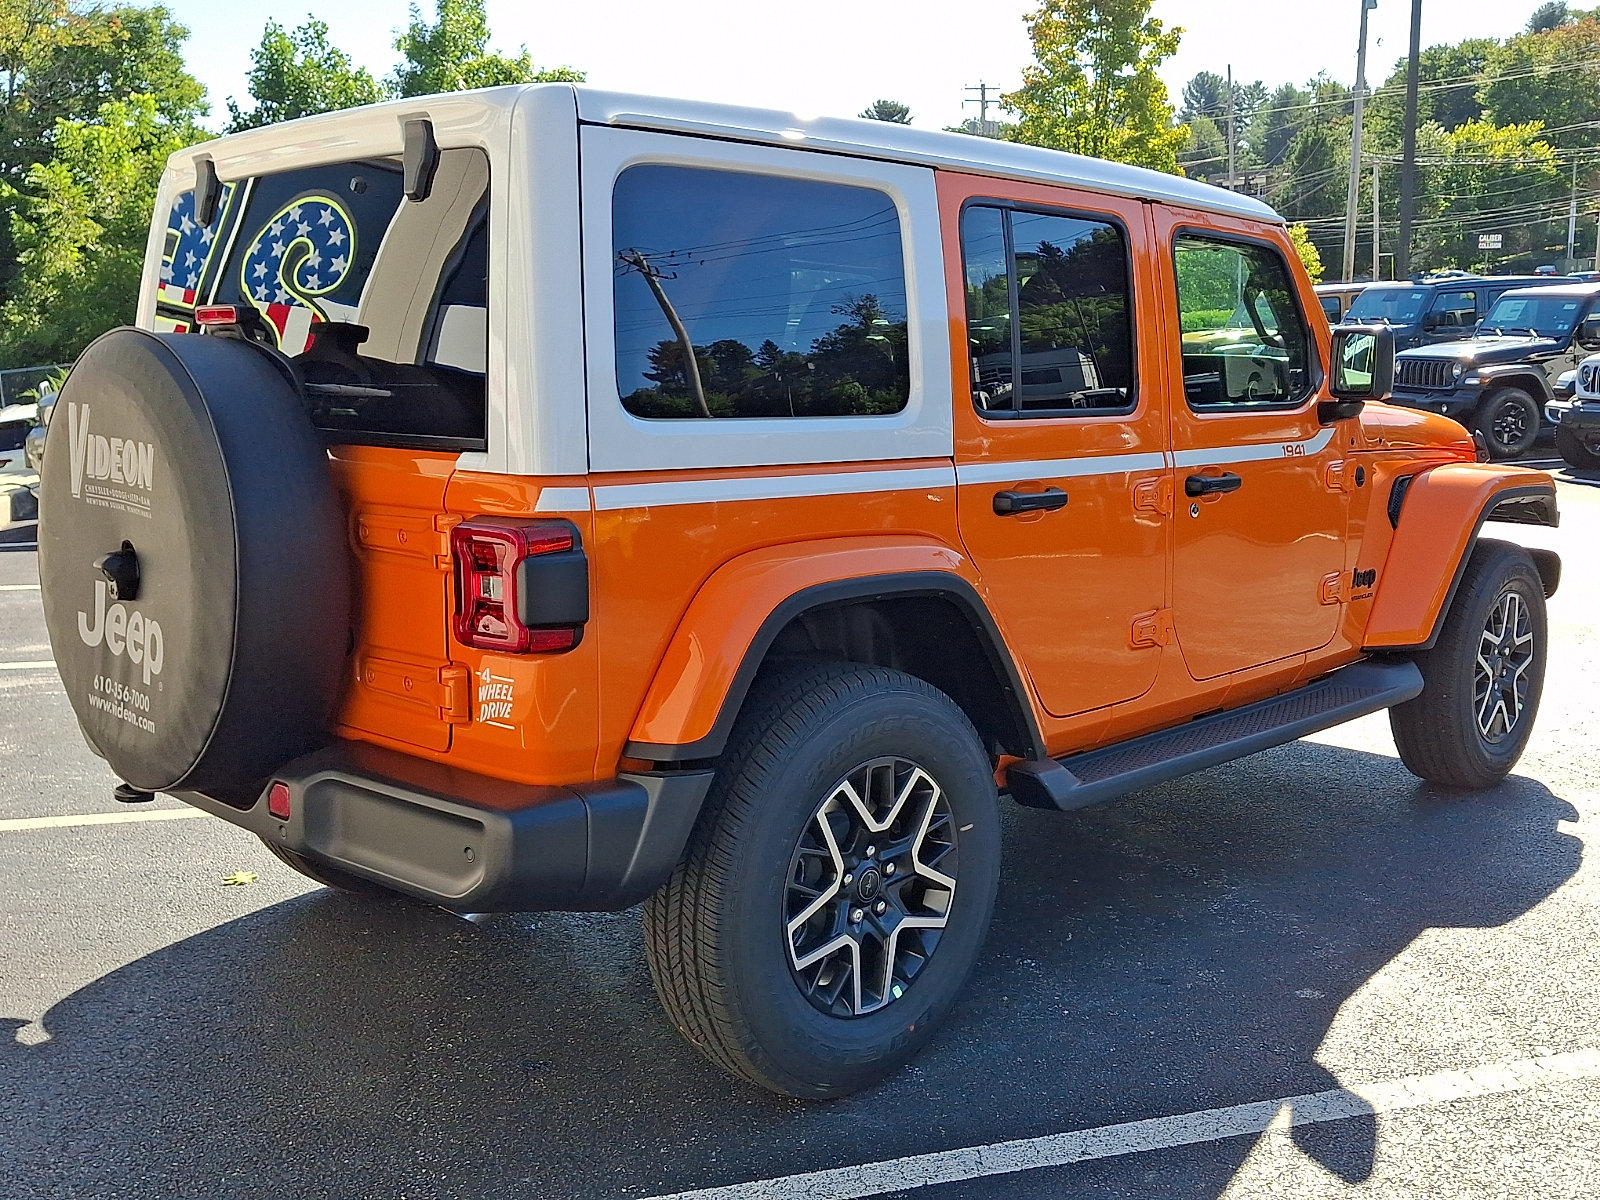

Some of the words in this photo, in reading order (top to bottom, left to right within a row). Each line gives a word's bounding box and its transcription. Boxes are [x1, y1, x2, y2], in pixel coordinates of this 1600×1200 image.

[68, 402, 154, 498] VIDEON
[1281, 444, 1306, 456] 1941
[77, 580, 164, 685] Jeep
[481, 667, 491, 683] 4
[93, 674, 150, 713] 610-356-7000
[478, 683, 513, 702] WHEEL
[88, 693, 156, 734] www.videon.com
[480, 701, 513, 723] DRIVE
